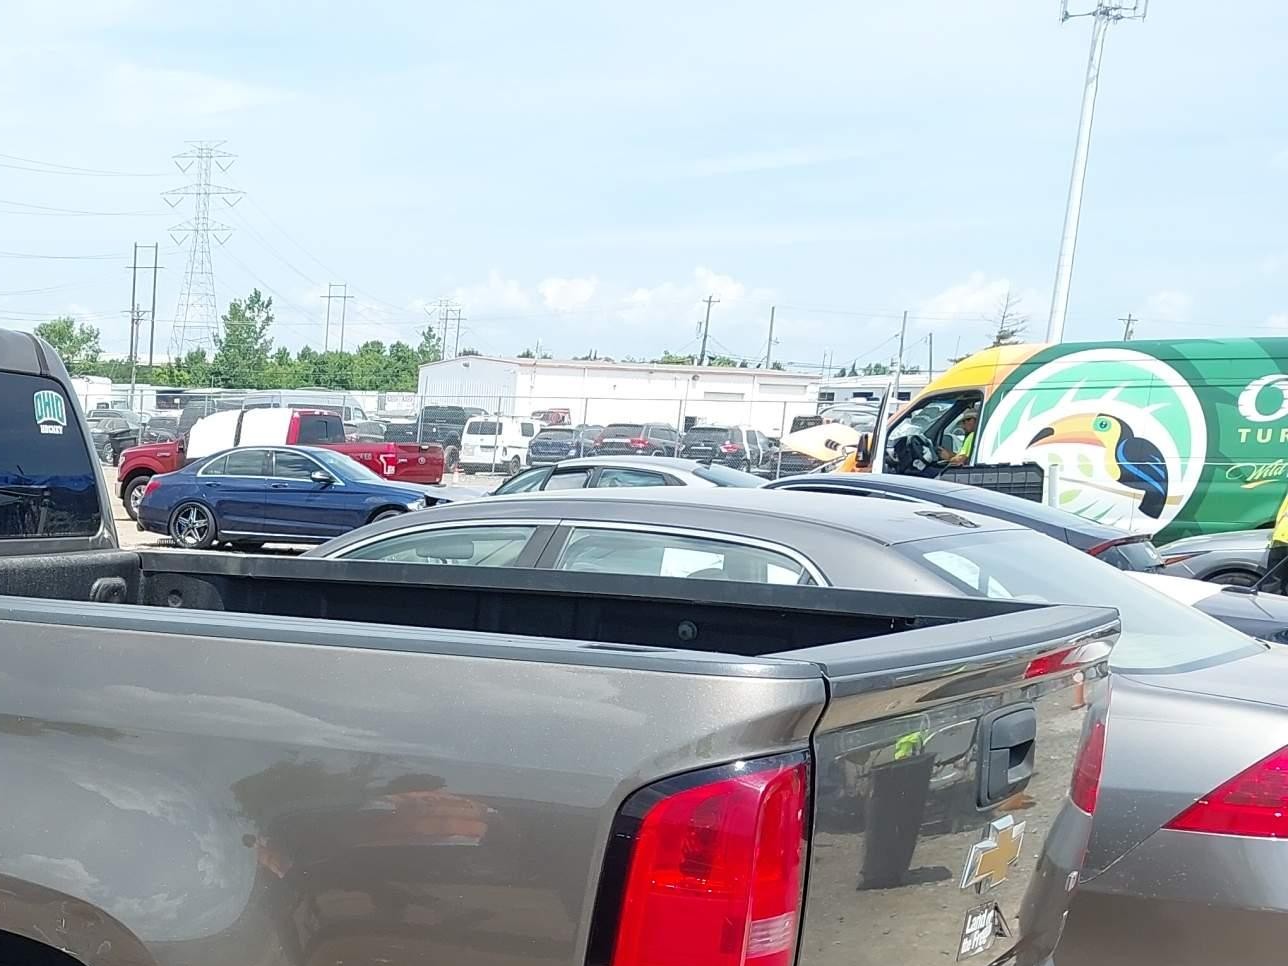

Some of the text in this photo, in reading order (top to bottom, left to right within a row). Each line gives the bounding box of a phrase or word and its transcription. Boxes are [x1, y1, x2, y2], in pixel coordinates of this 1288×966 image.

[34, 390, 67, 426] OHIO
[1225, 459, 1285, 481] Wild
[965, 909, 988, 935] Land
